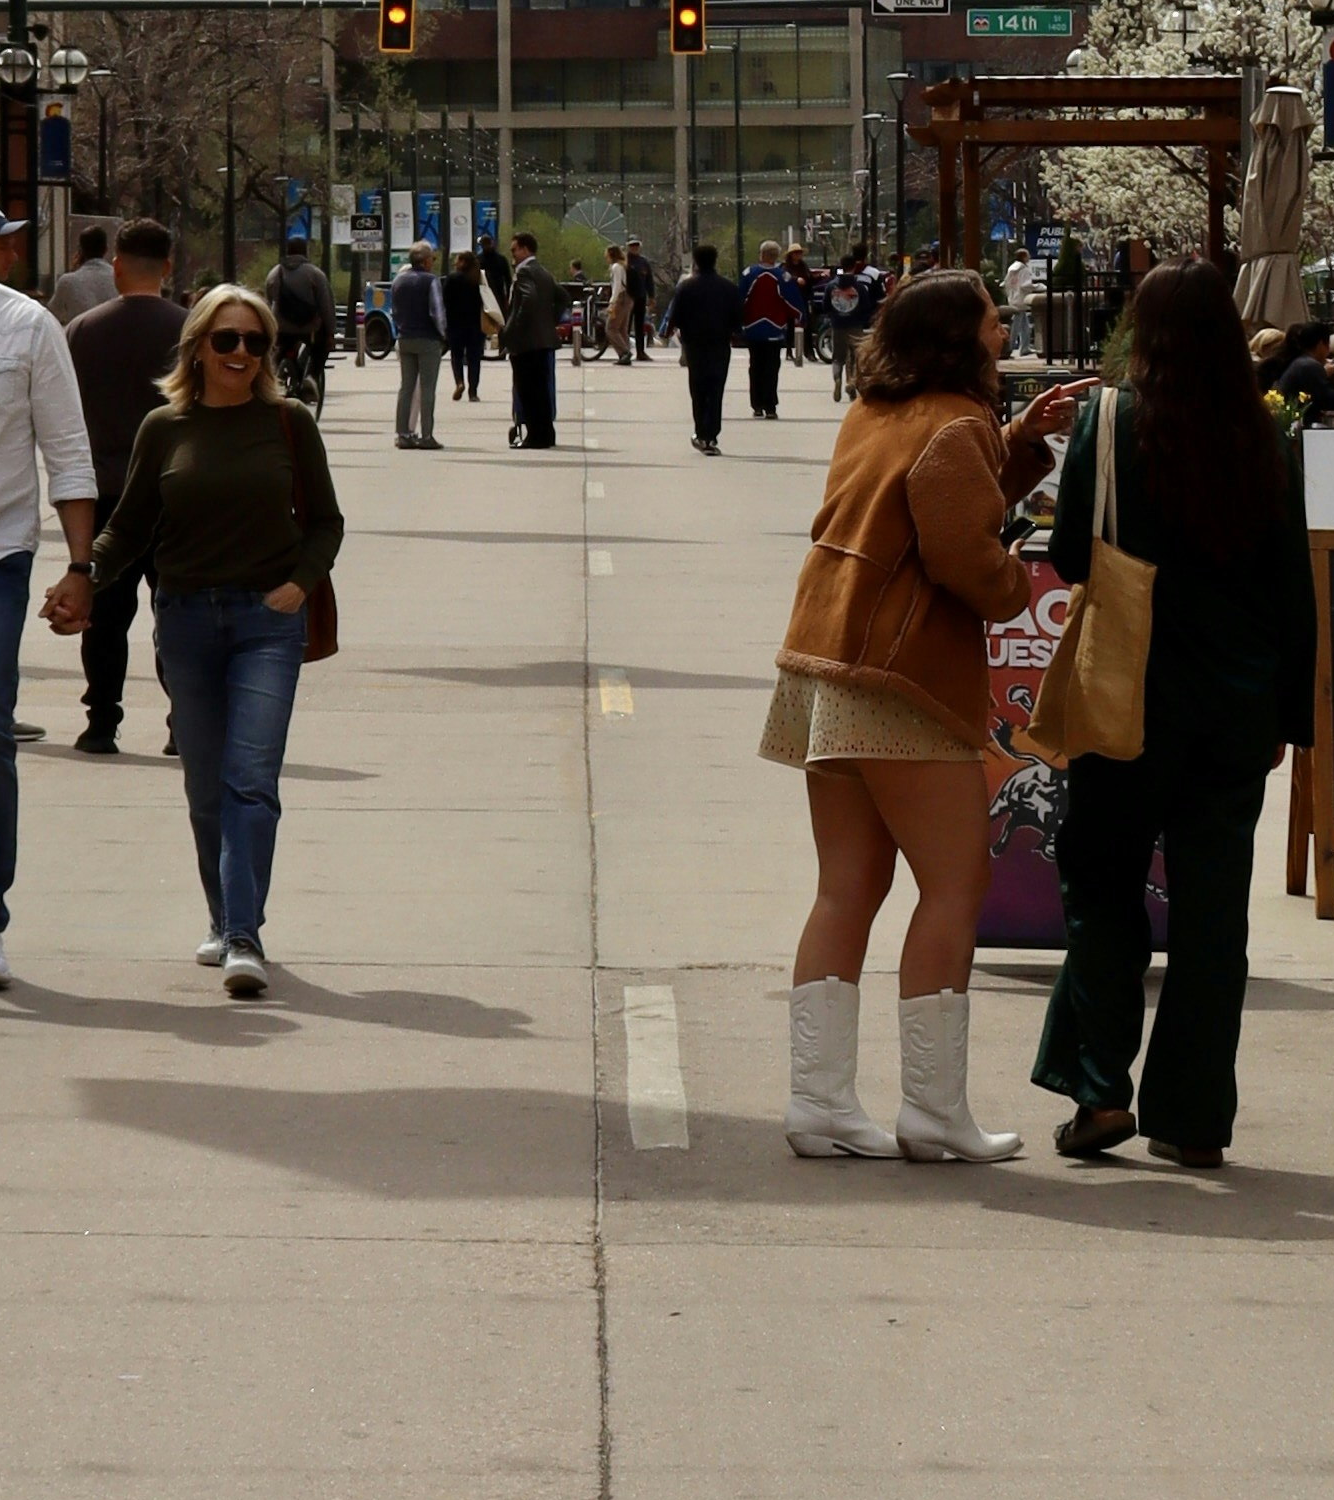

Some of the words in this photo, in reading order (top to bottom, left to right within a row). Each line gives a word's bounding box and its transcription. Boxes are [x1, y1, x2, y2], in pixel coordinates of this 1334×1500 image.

[997, 14, 1037, 31] 14th
[1053, 14, 1062, 22] St
[1048, 23, 1067, 31] 1400
[986, 638, 1060, 668] UES
